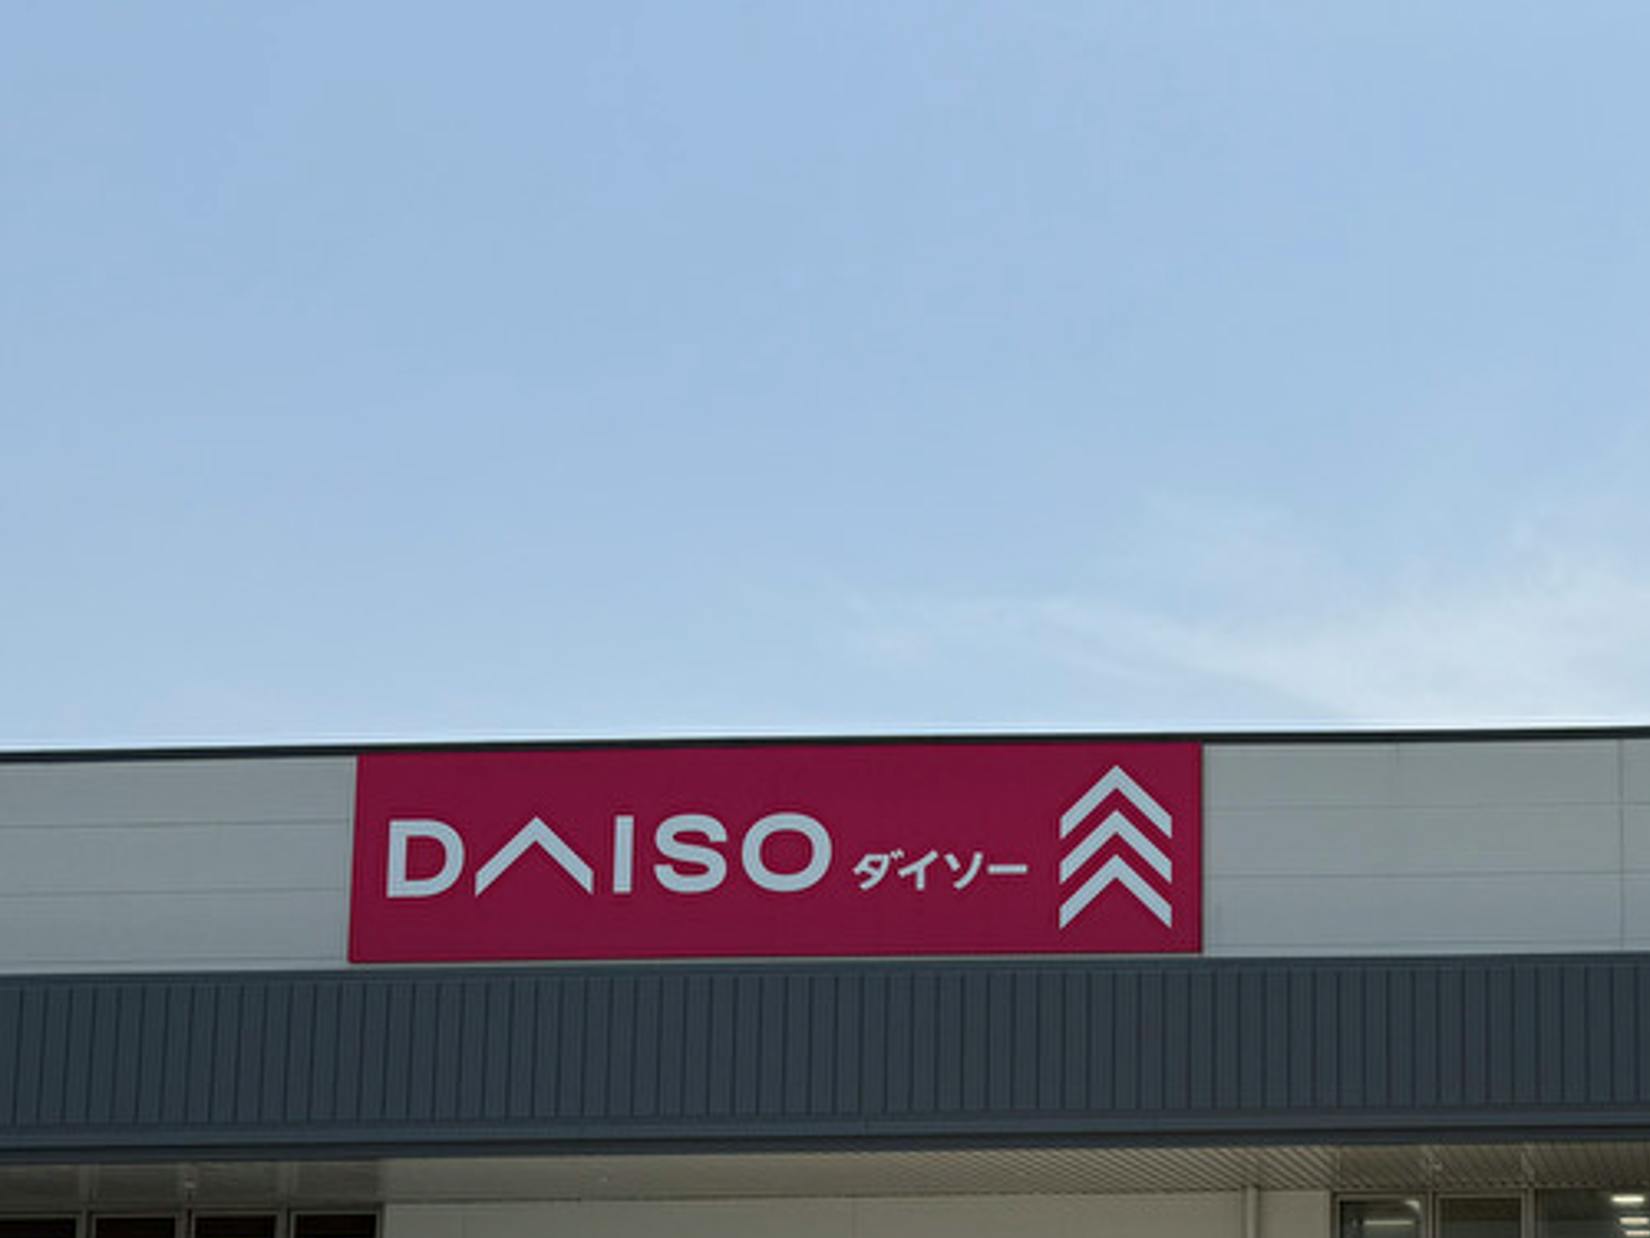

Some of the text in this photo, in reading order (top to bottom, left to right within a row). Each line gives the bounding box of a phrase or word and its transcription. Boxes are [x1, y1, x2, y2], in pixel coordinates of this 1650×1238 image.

[386, 812, 1029, 899] DAISO ダイソー
